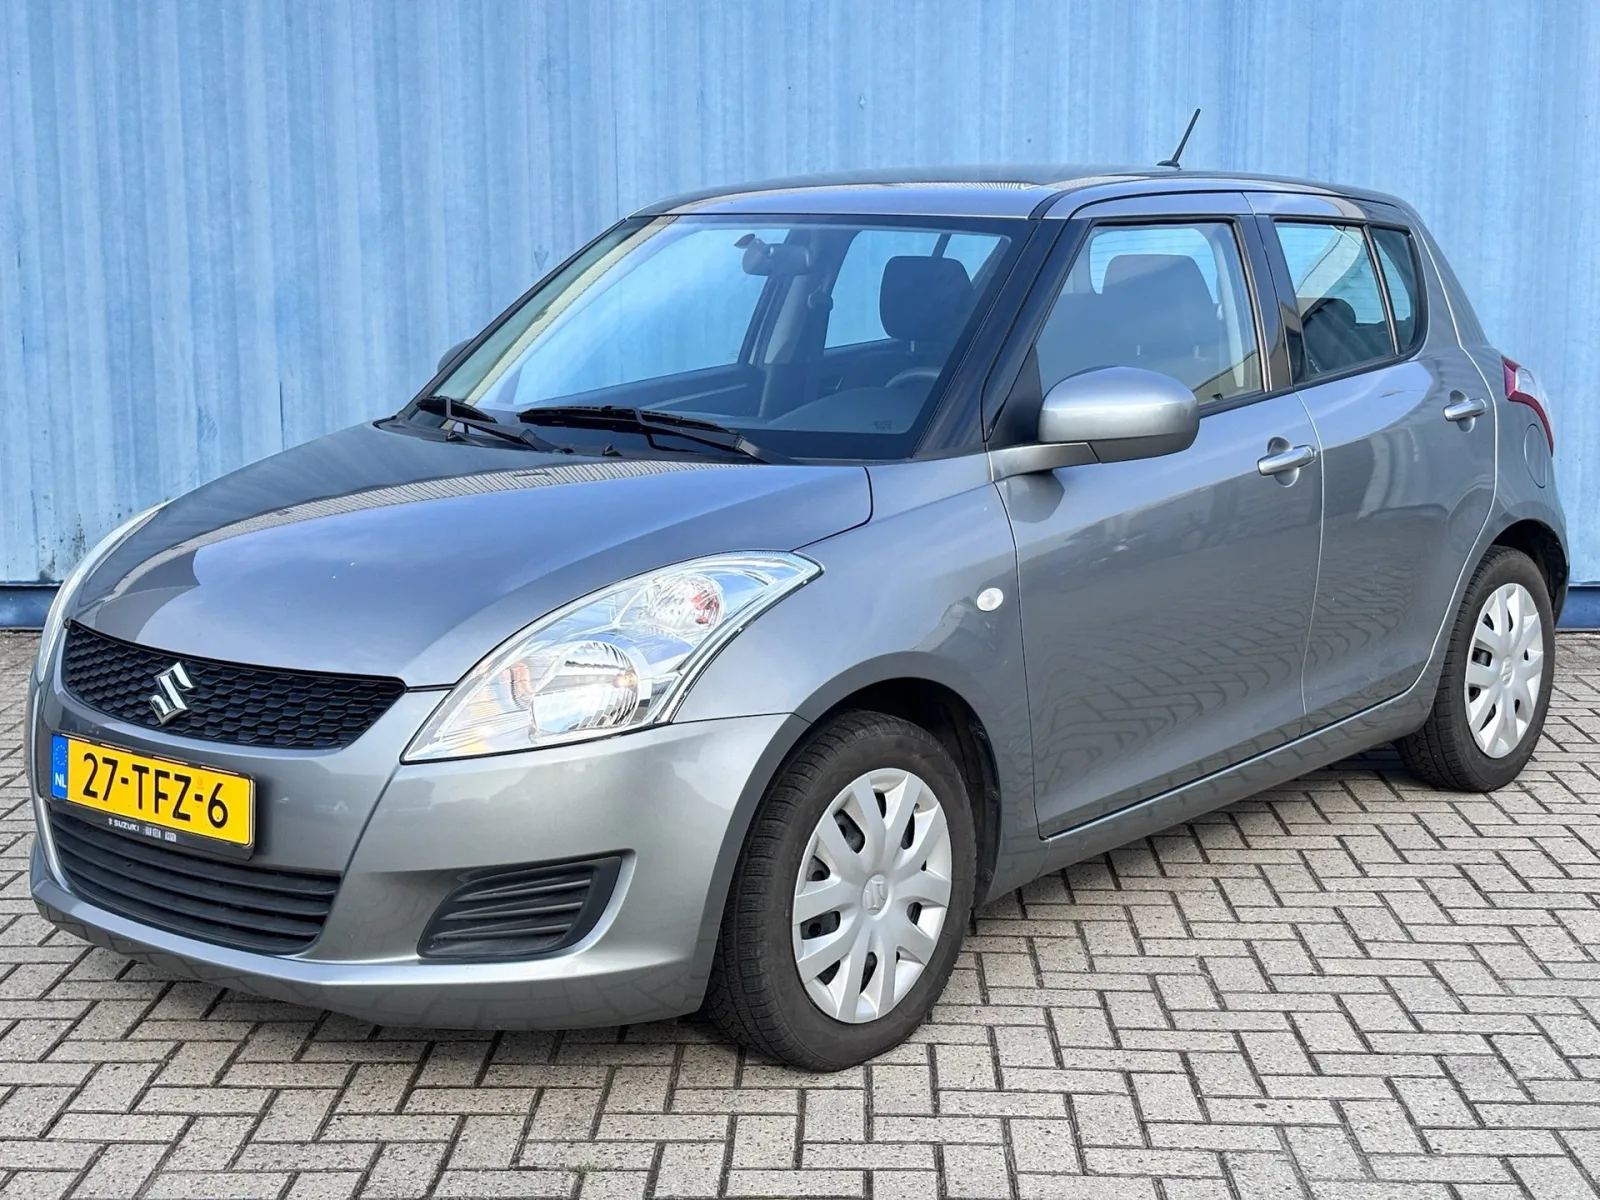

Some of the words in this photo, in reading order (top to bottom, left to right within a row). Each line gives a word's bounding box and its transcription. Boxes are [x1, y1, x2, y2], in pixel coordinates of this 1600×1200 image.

[54, 772, 67, 788] NL
[82, 752, 229, 829] 27-TFZ-6
[113, 819, 140, 832] SUZUKI
